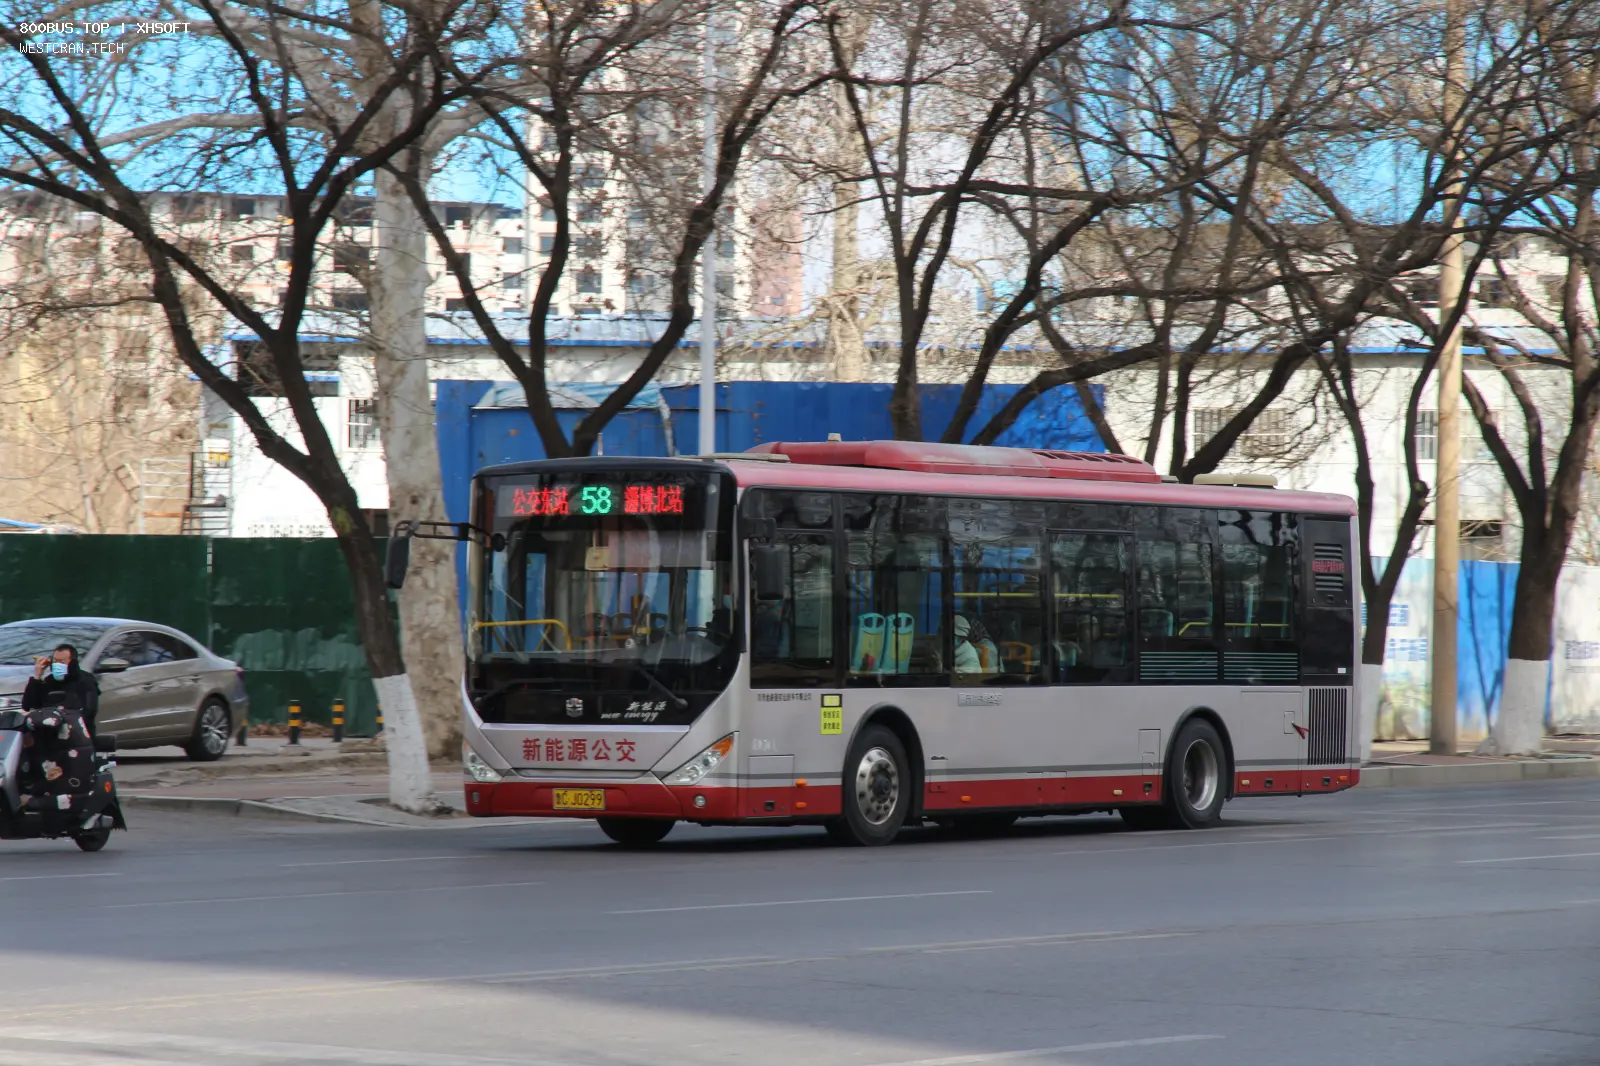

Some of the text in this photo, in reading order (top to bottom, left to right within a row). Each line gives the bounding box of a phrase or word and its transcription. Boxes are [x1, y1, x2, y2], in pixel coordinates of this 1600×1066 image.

[581, 486, 612, 515] 58
[522, 738, 636, 762] 新能源公交
